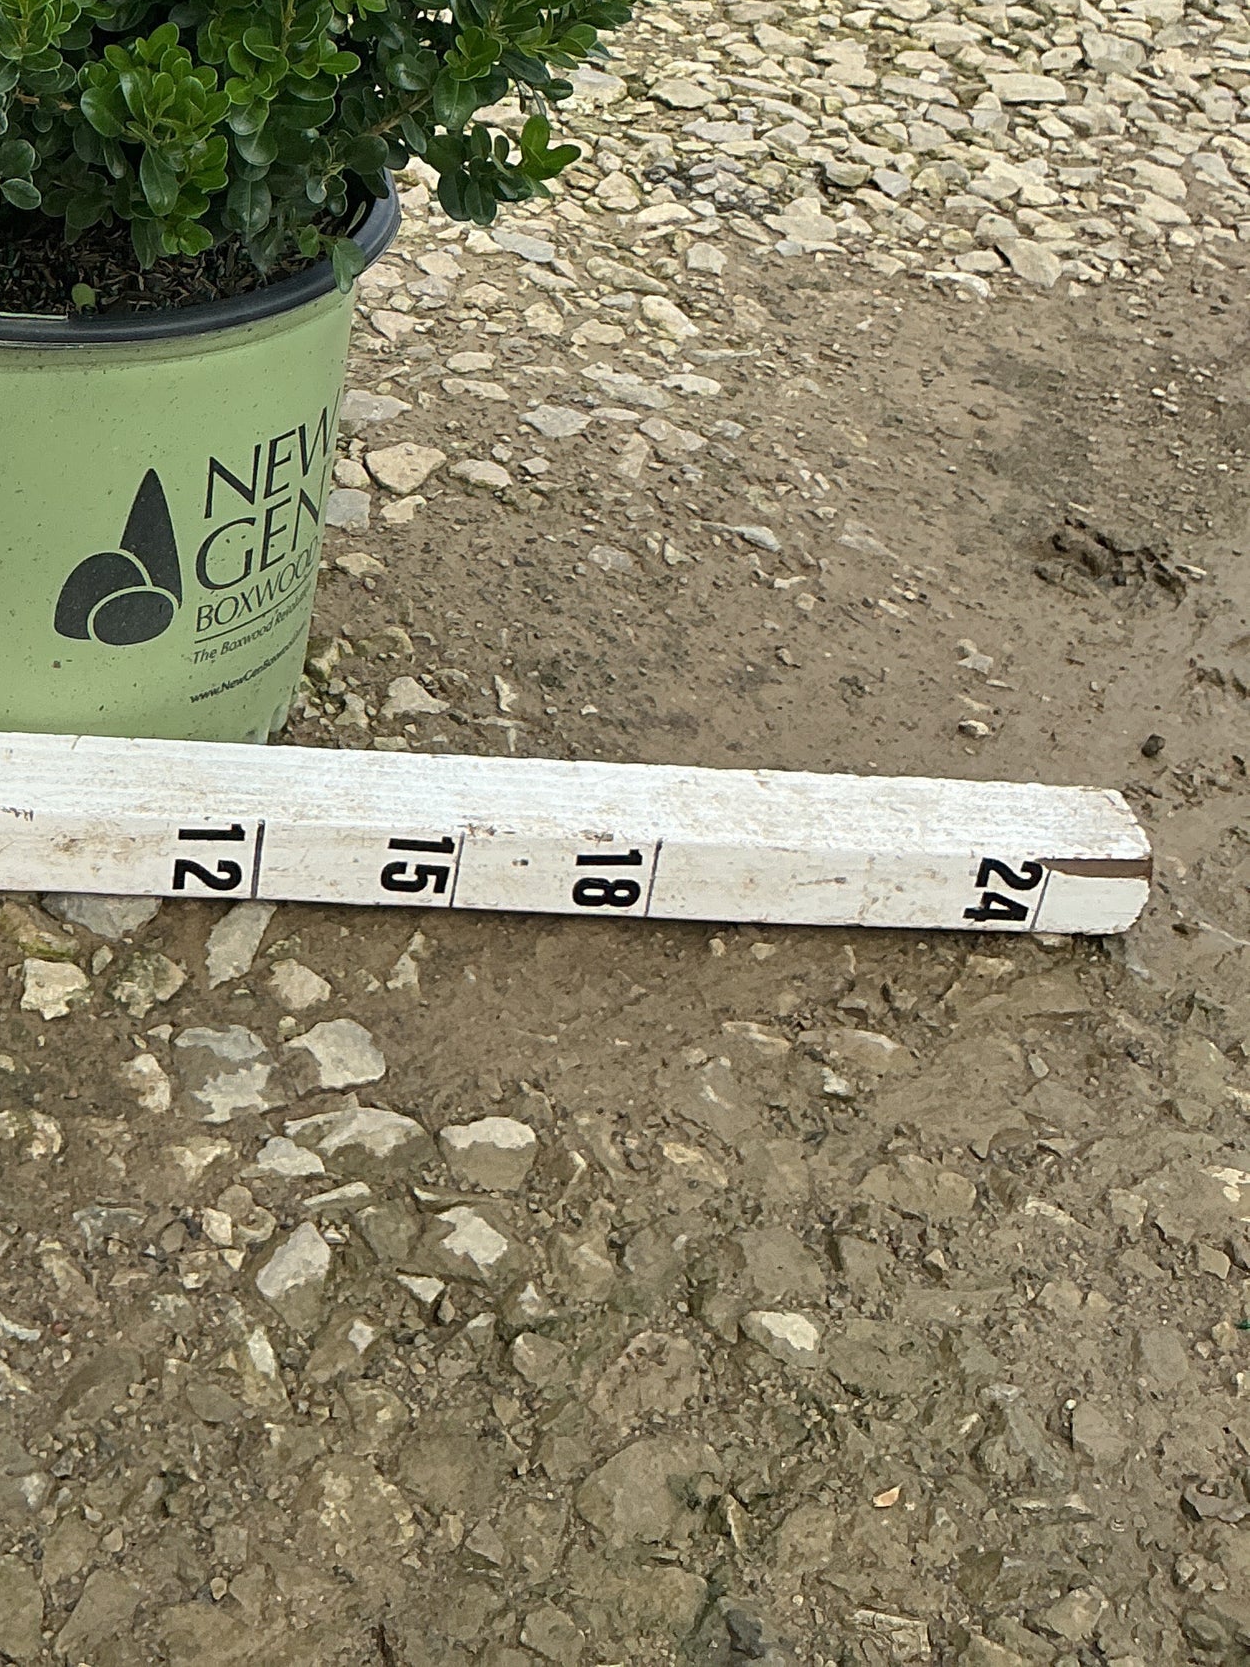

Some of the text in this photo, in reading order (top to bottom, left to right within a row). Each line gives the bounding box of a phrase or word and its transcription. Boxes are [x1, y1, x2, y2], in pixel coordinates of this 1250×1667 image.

[204, 387, 341, 519] NEW
[195, 464, 327, 590] GEN
[193, 649, 218, 664] The
[220, 616, 274, 656] Boxwood
[172, 823, 246, 891] 12
[380, 836, 455, 894] 15
[572, 848, 642, 907] 18
[962, 857, 1043, 922] 24
